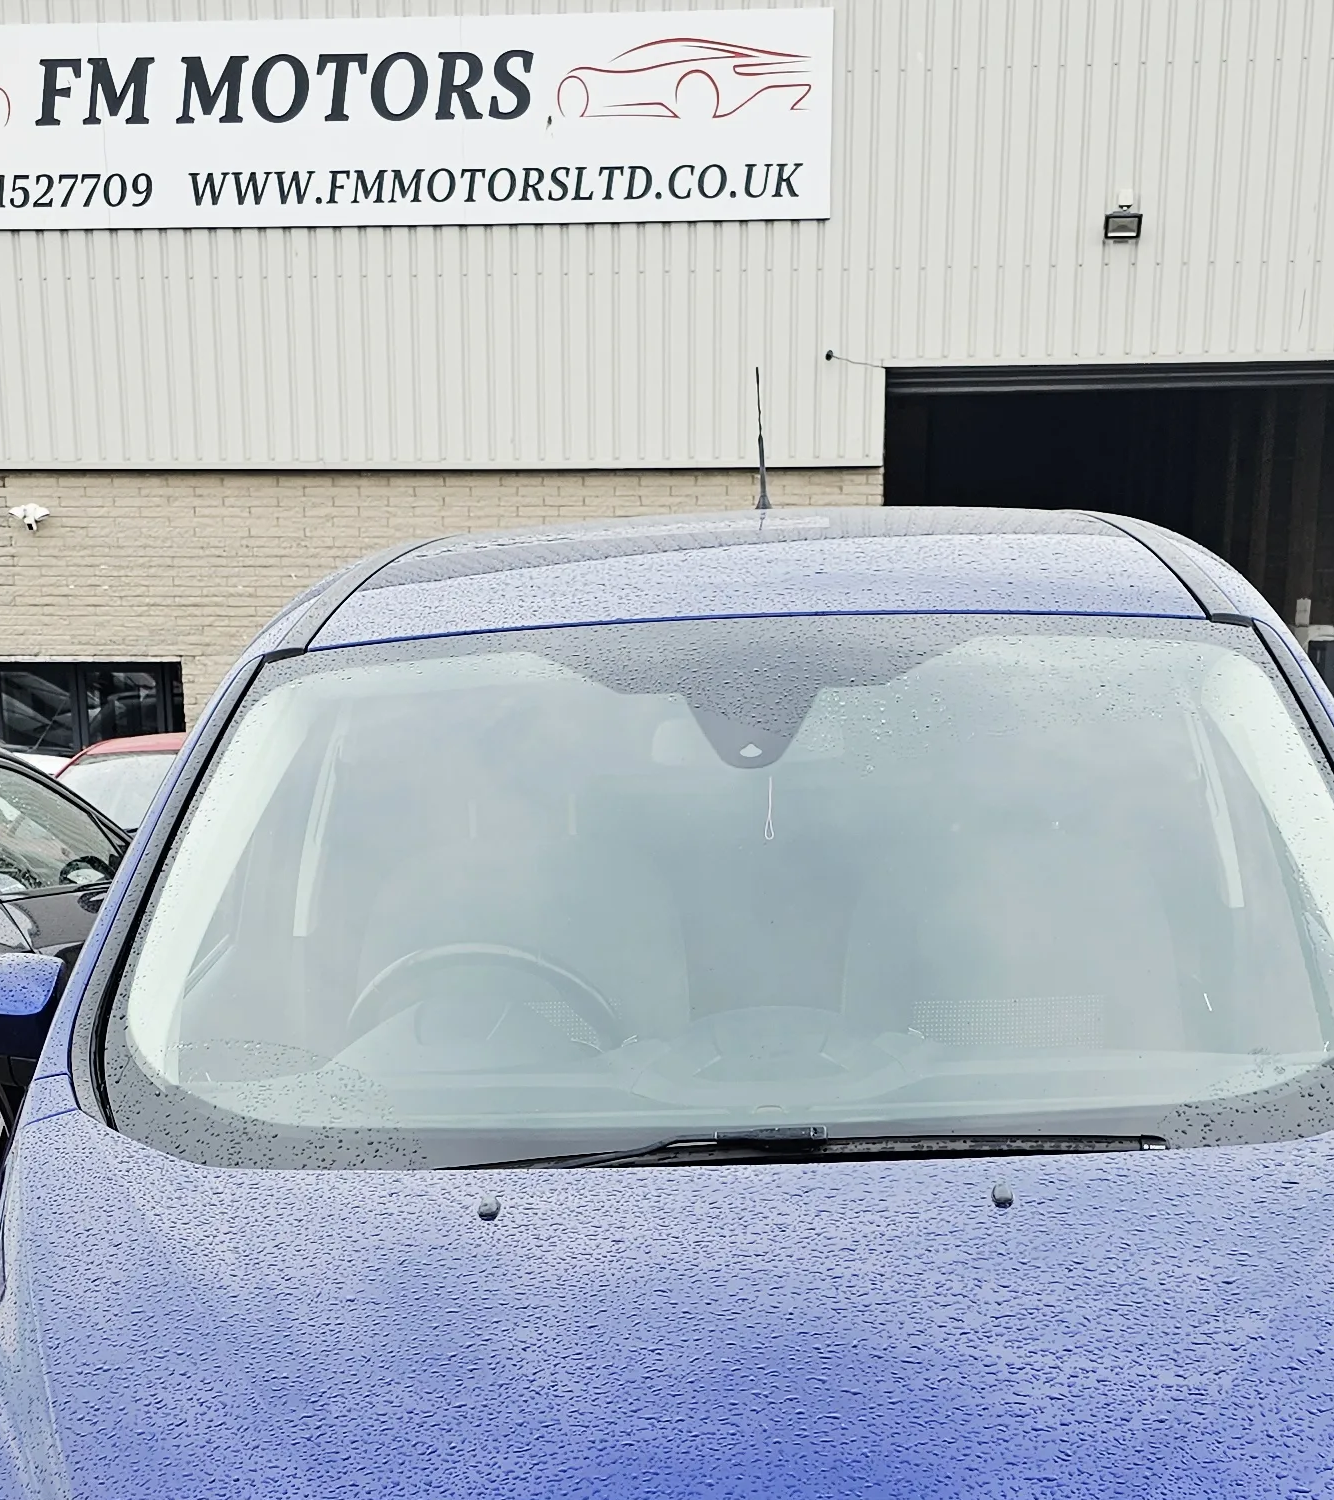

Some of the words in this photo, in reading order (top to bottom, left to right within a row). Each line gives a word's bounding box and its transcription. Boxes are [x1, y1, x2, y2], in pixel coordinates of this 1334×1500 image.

[35, 56, 155, 126] FM
[175, 49, 534, 124] MOTORS
[188, 163, 804, 205] WWW.FMMOTORSLTD.CO.UK
